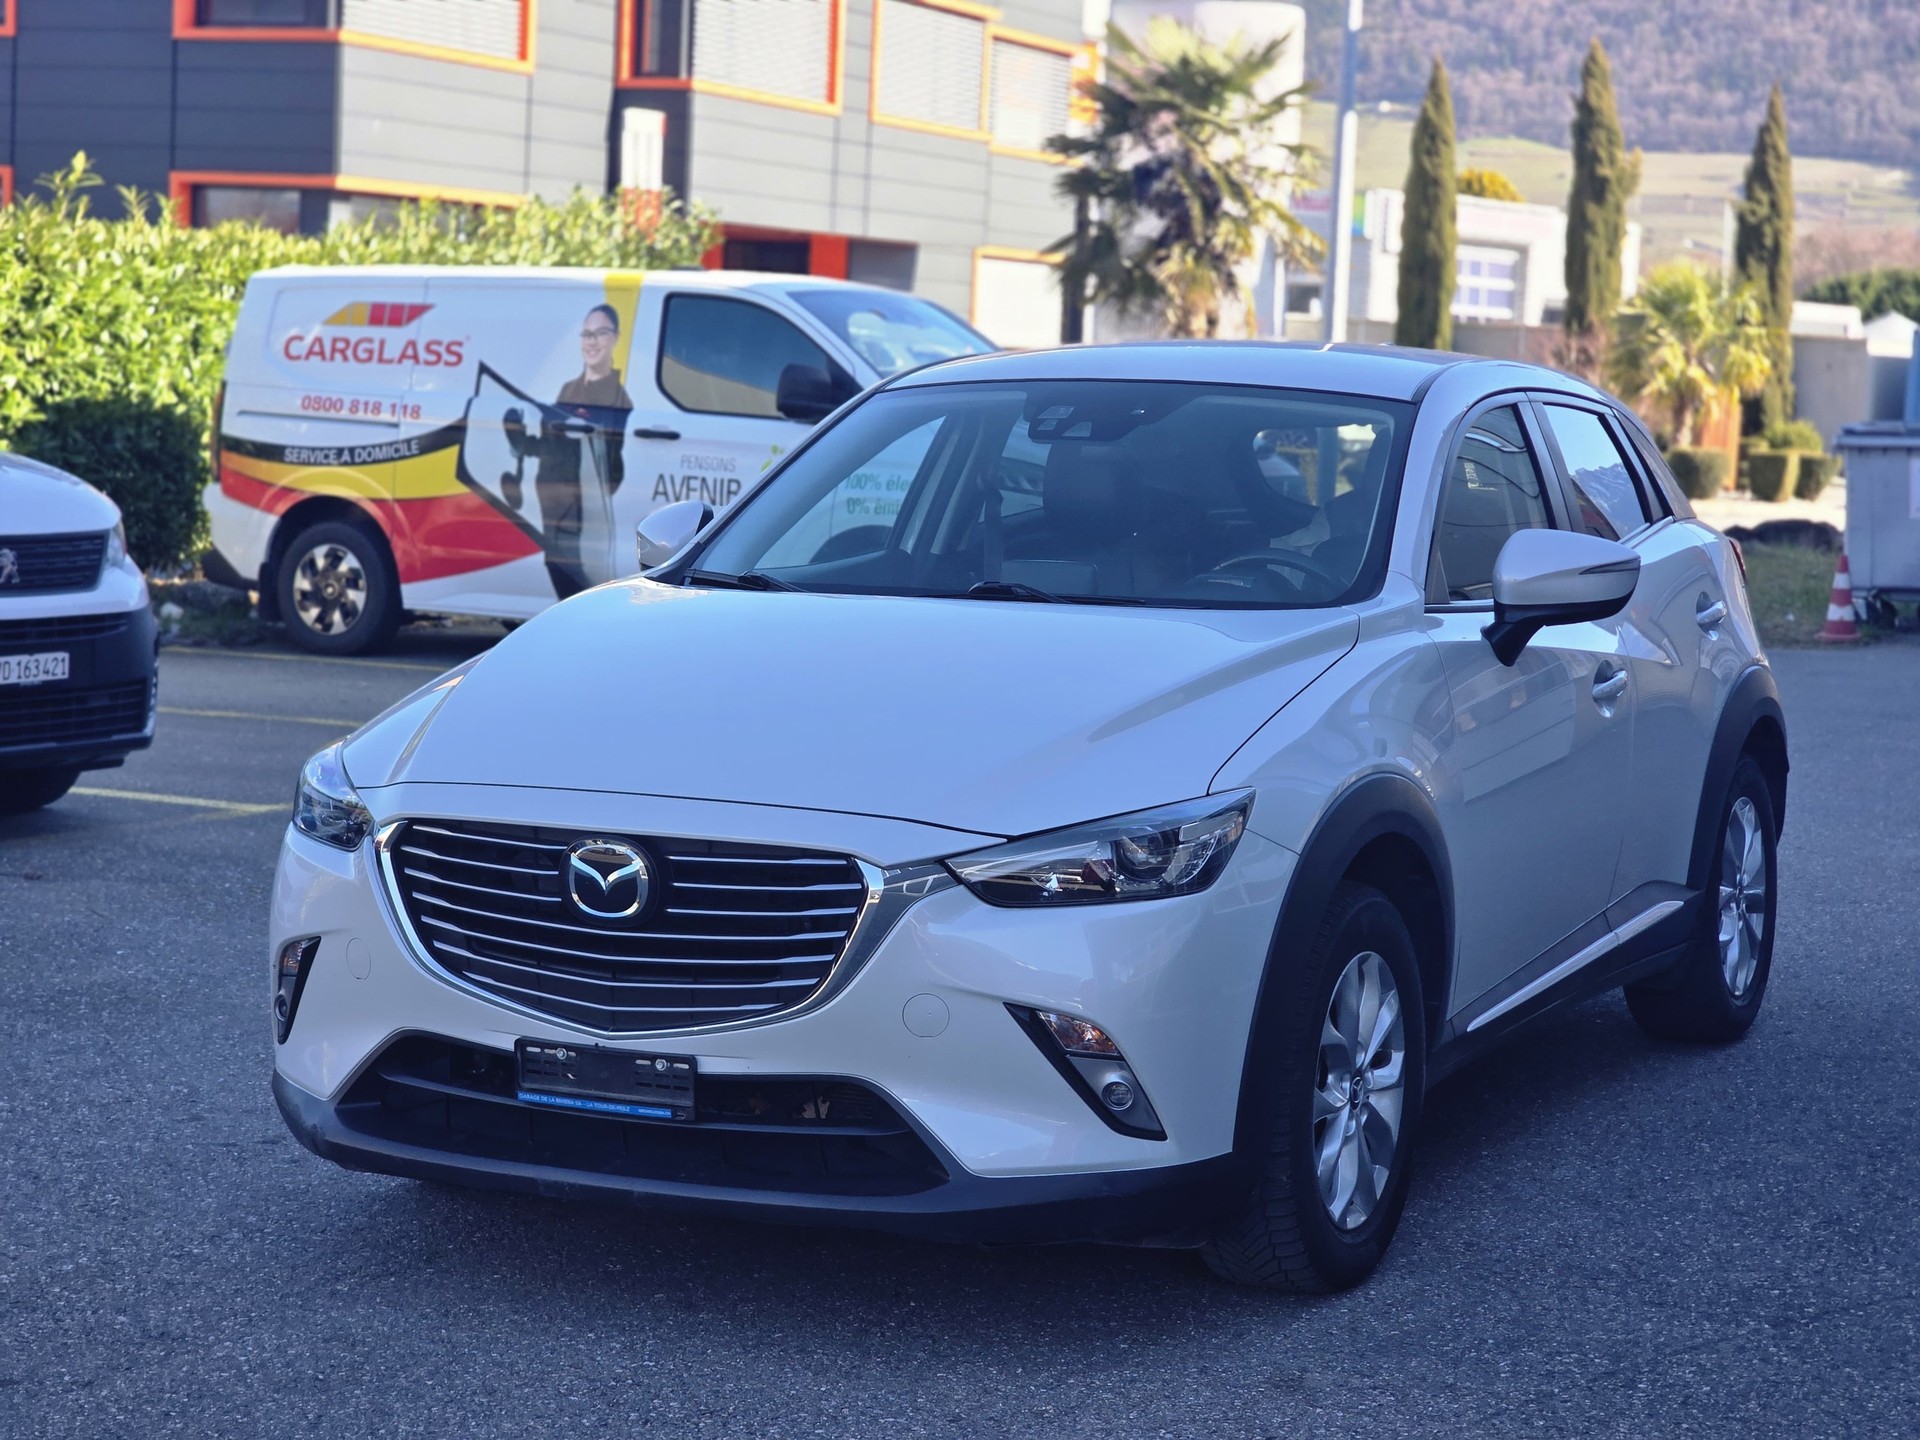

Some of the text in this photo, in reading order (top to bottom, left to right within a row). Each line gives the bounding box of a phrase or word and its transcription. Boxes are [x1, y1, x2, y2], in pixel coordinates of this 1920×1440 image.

[283, 335, 464, 367] CARGLASS
[301, 395, 421, 420] 0800 818 118
[284, 447, 340, 464] SERVICE
[354, 439, 420, 463] DOMICILE
[680, 454, 736, 473] PENSONS
[845, 473, 882, 491] 100%
[846, 497, 870, 515] 0%
[0, 660, 11, 681] D
